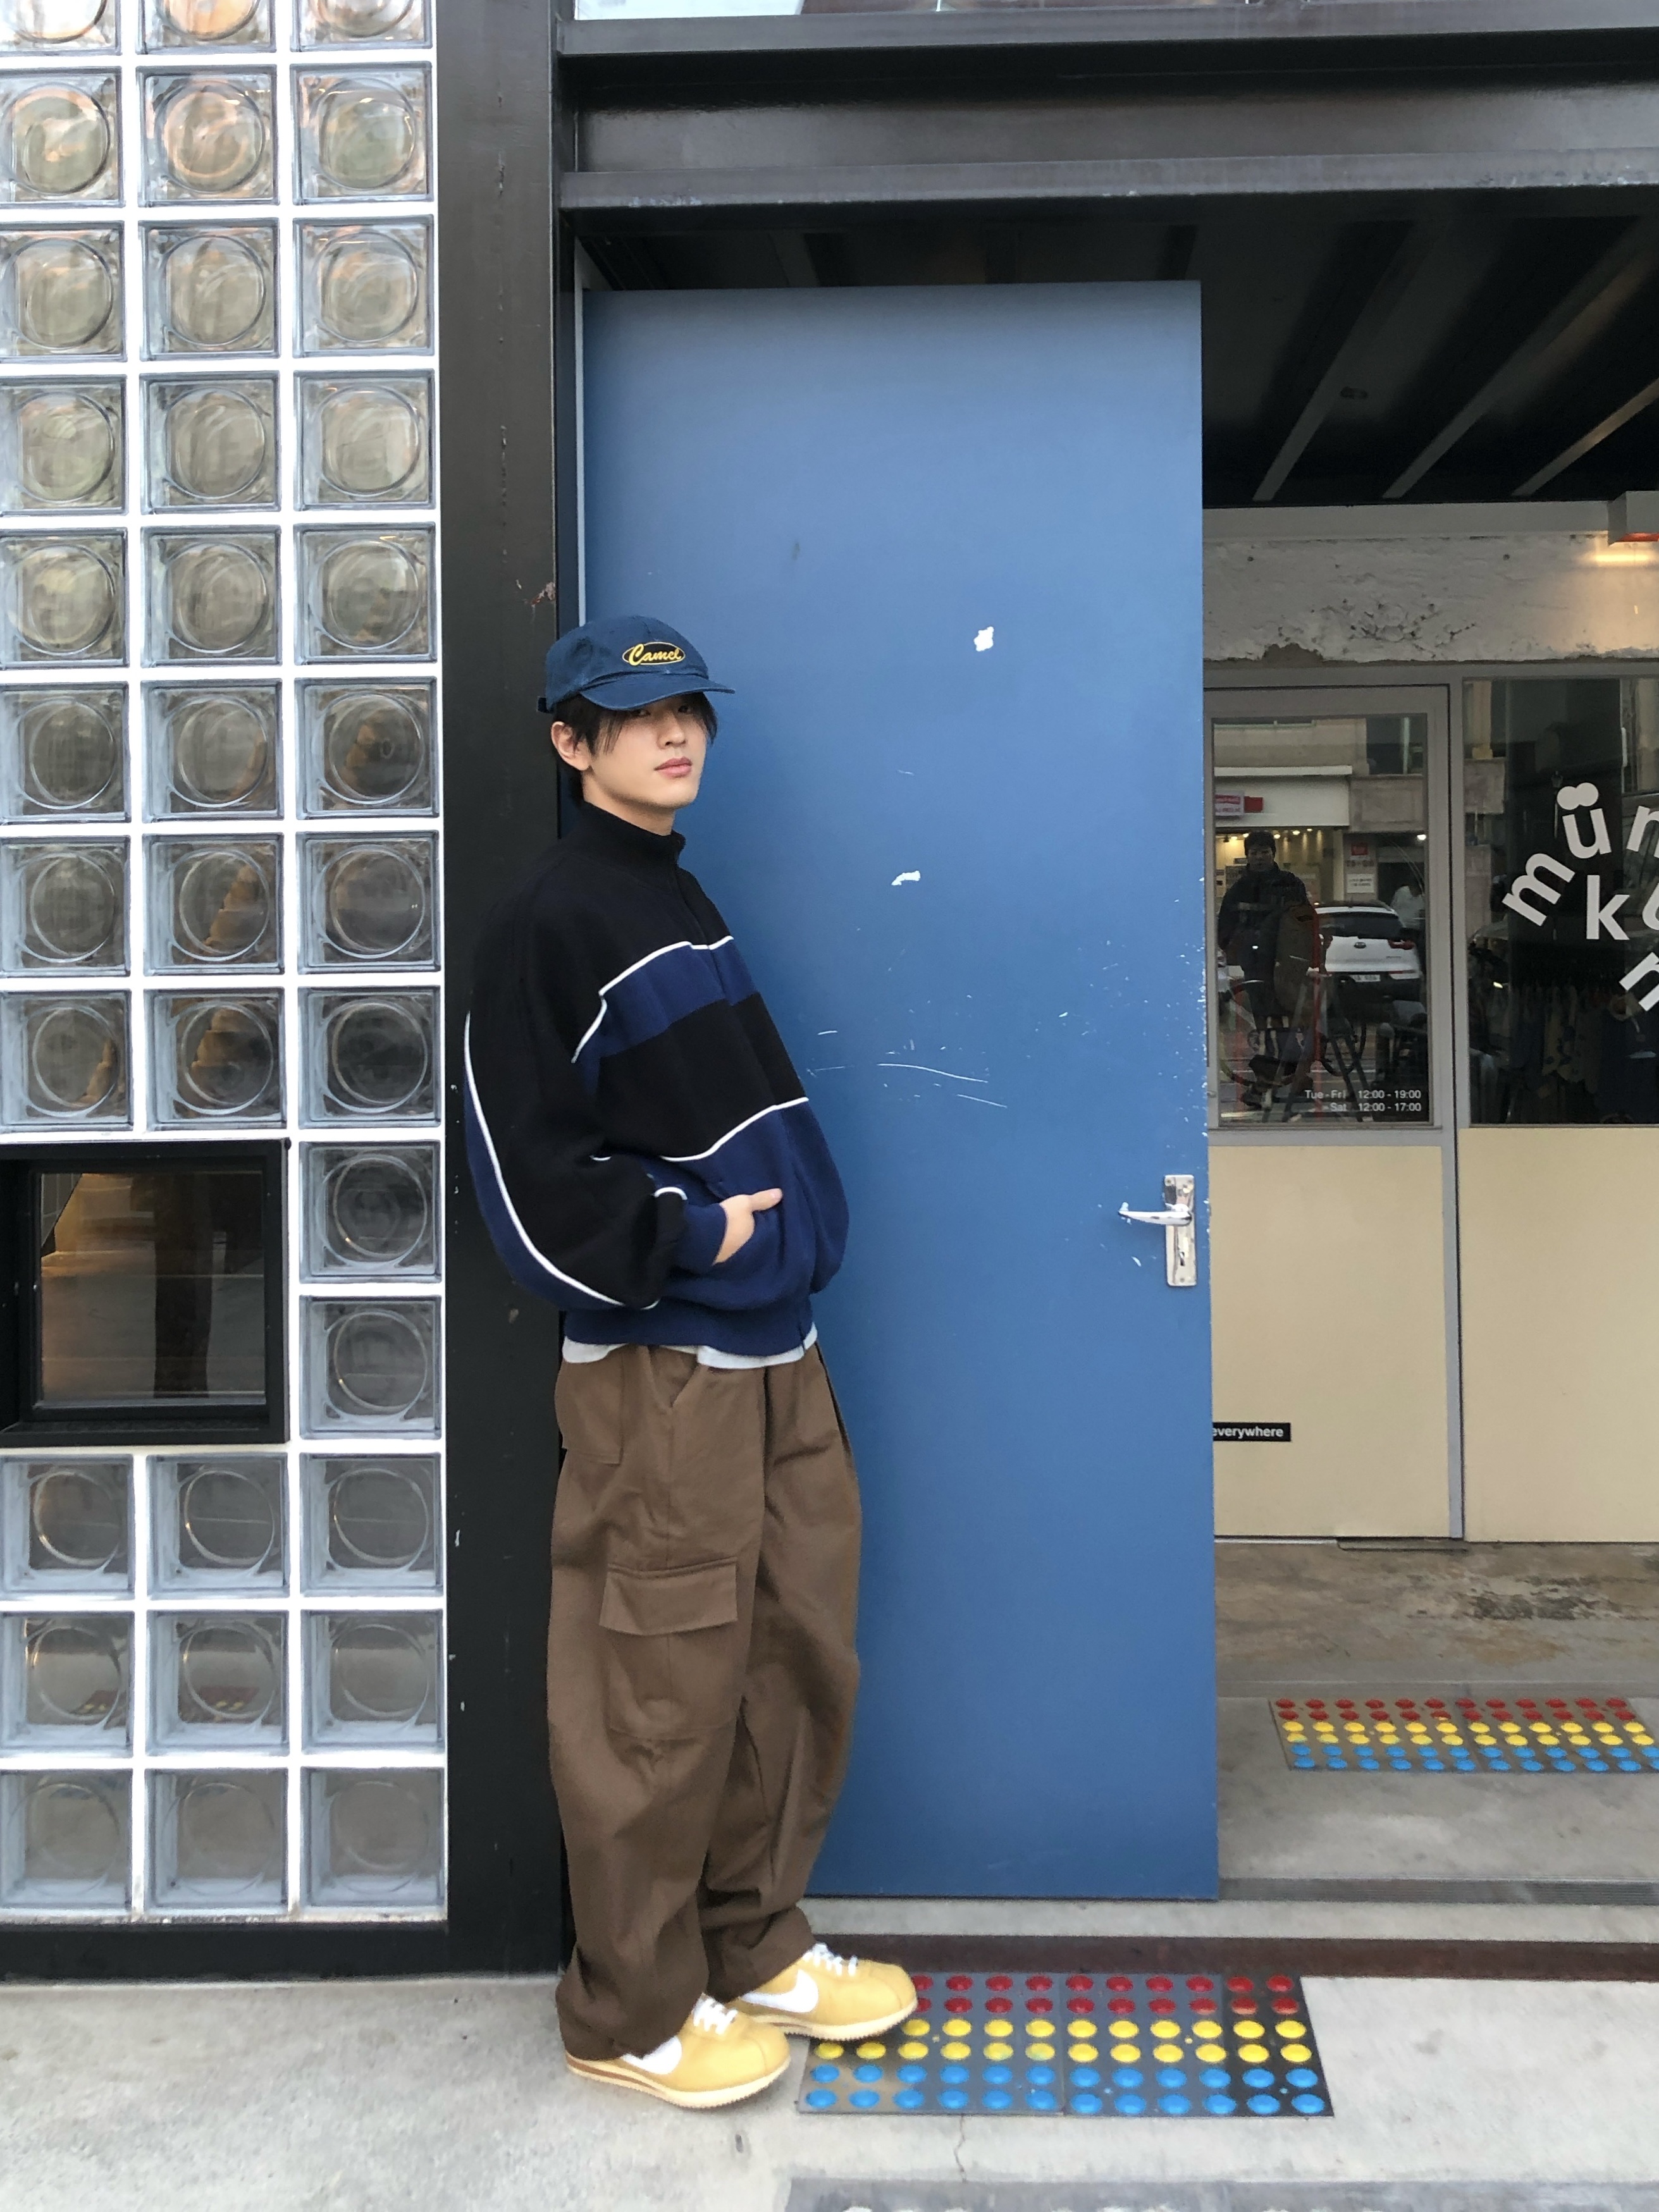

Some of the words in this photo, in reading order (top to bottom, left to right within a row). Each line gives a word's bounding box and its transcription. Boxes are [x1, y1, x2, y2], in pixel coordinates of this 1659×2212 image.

[629, 644, 682, 666] Camel
[1358, 1090, 1385, 1099] 12:00
[1394, 1090, 1422, 1099] 19:00
[1330, 1102, 1347, 1112] Sat
[1358, 1102, 1385, 1112] 12:00
[1395, 1102, 1422, 1112] 17:00
[1212, 1425, 1284, 1439] everywhere
